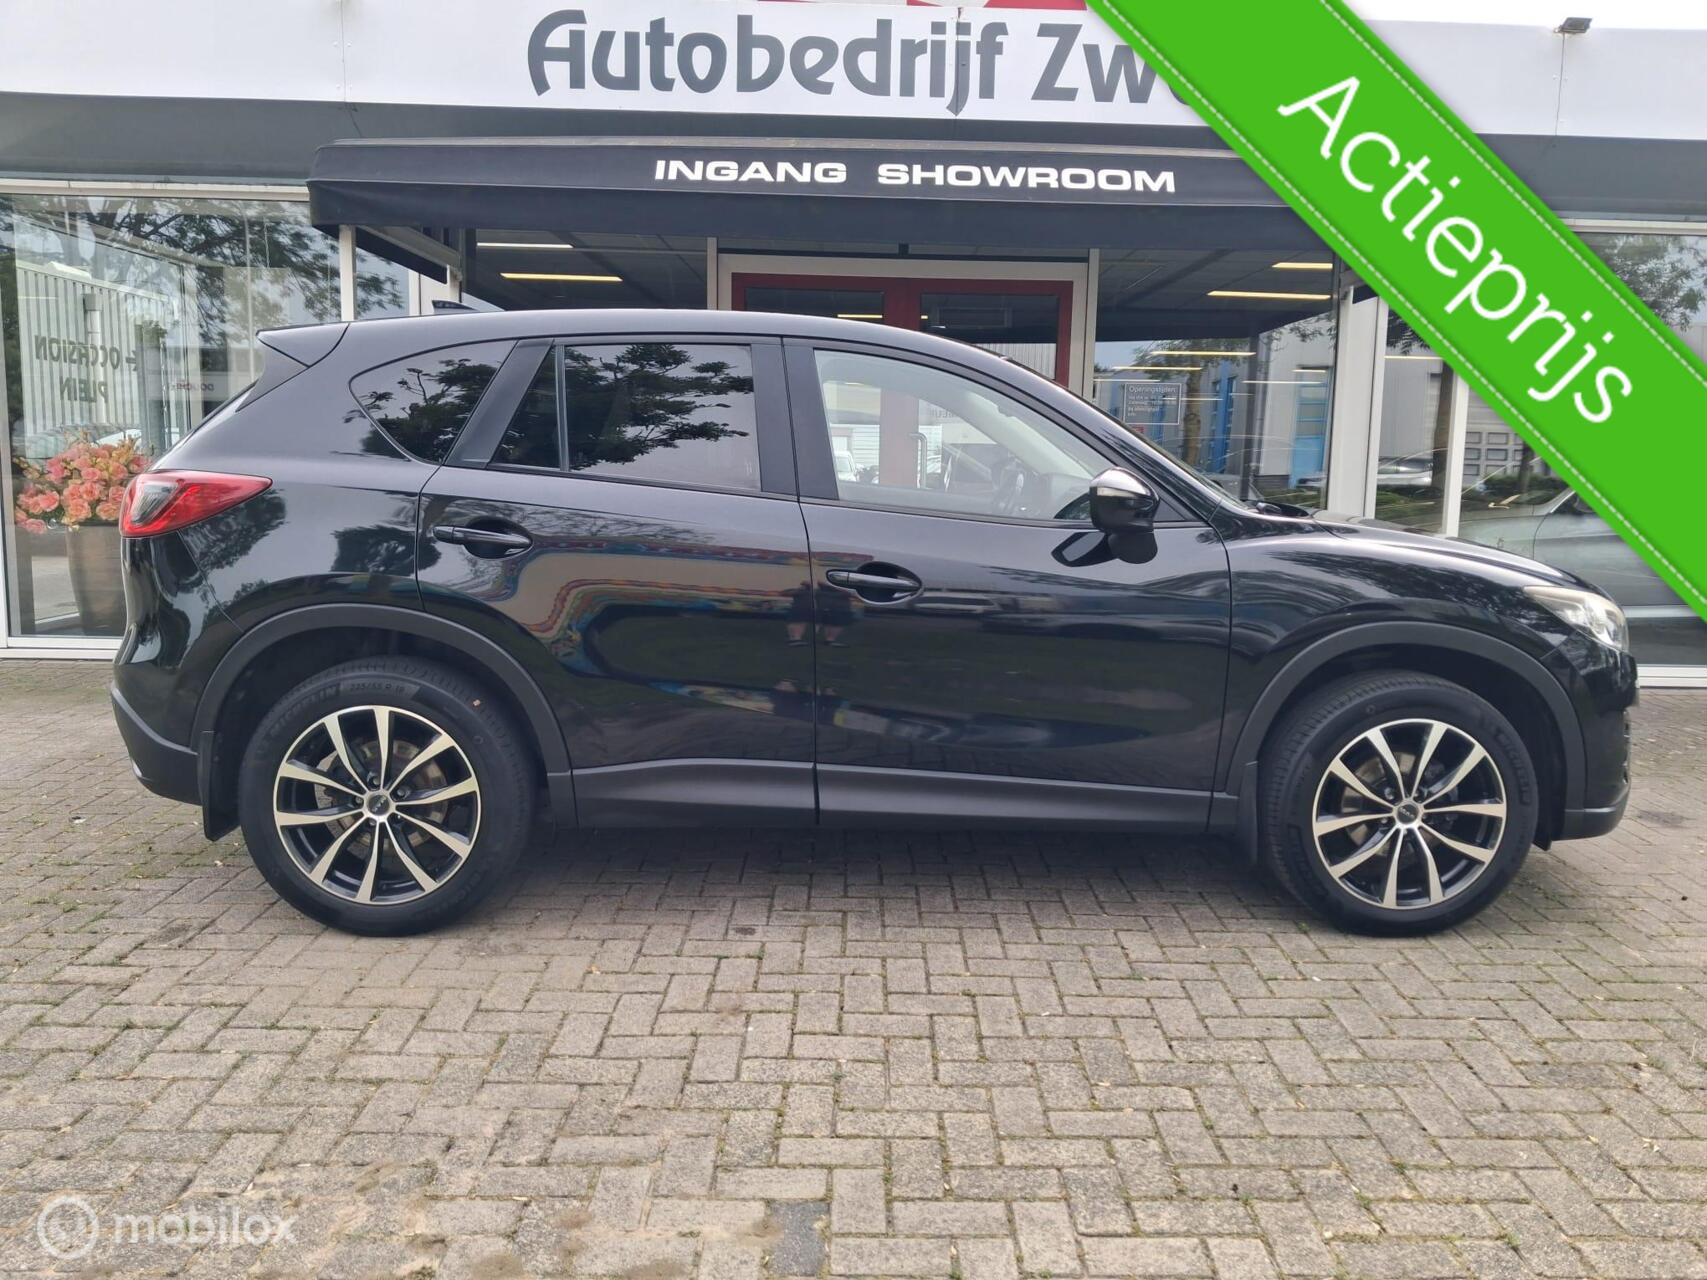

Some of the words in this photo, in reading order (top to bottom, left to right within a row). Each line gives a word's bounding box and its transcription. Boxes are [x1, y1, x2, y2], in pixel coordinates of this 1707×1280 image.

[527, 9, 1007, 116] Autobedrijf
[1031, 23, 1190, 106] Zw
[655, 160, 847, 183] INGANG
[877, 163, 1176, 192] SHOWROOM
